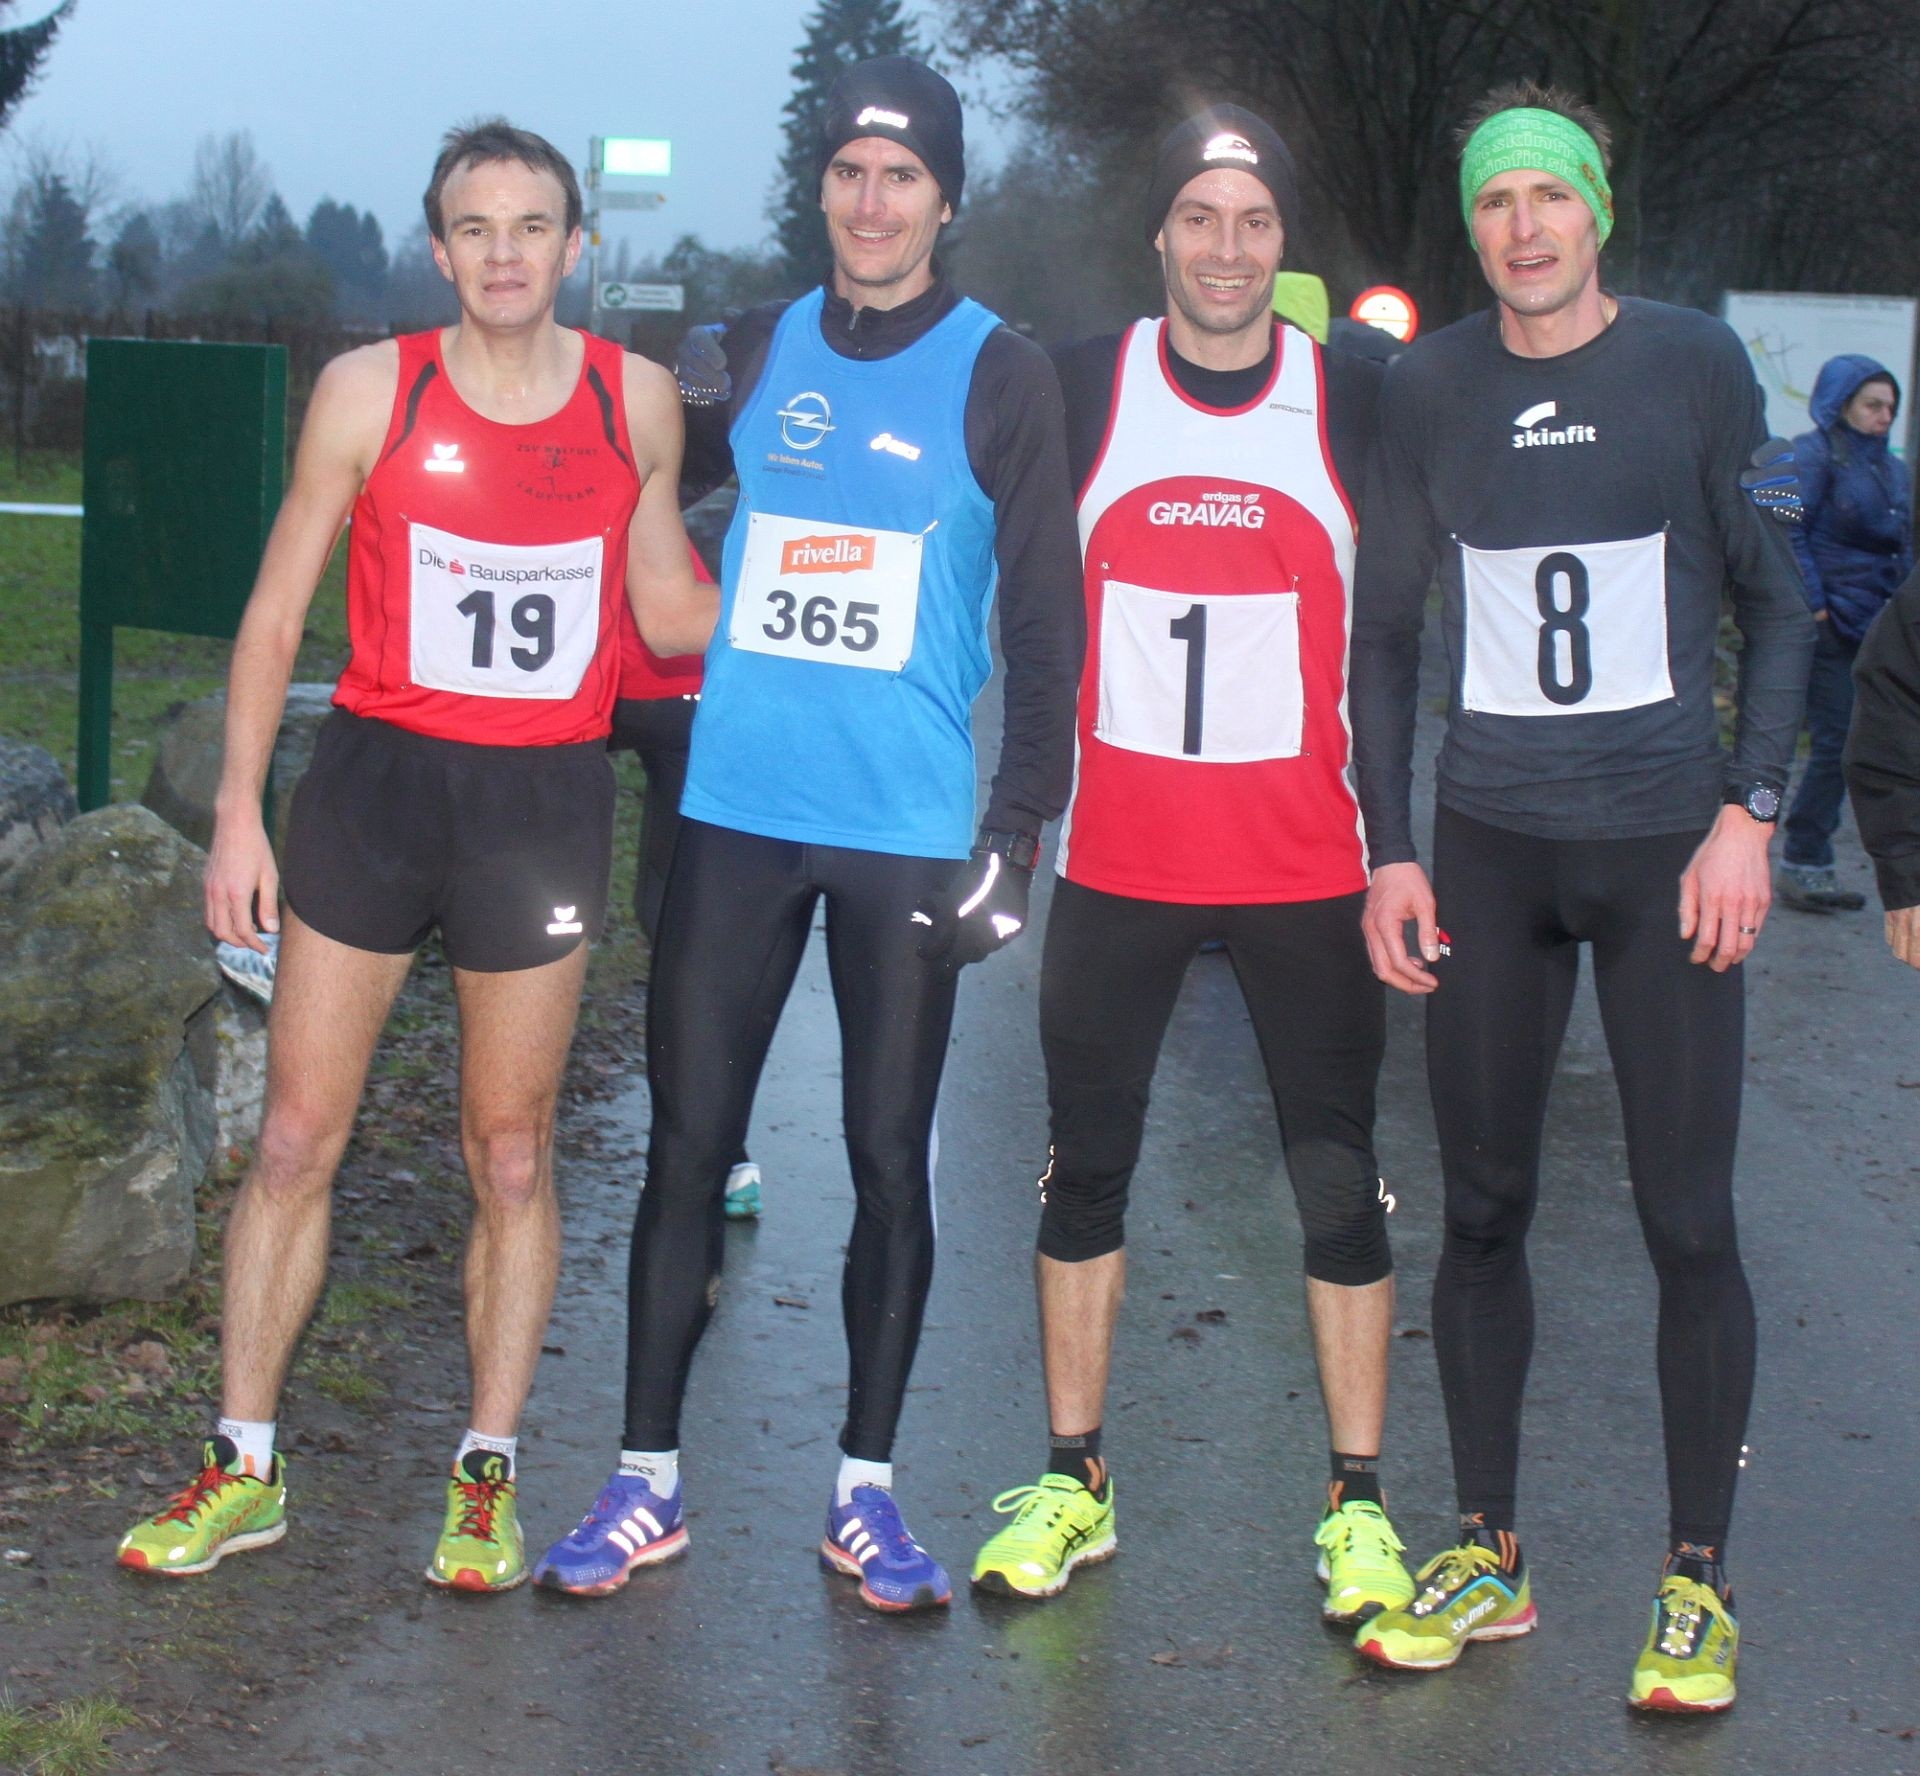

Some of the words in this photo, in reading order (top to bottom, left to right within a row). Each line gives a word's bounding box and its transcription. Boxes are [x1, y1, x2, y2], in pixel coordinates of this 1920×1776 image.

[1512, 425, 1596, 449] skinfit
[1149, 501, 1265, 528] GRAVAG
[1202, 492, 1242, 504] erdgas
[419, 549, 446, 569] Die
[470, 563, 594, 585] Bausparkasse
[791, 538, 863, 566] rivella
[456, 589, 556, 672] 19
[762, 589, 880, 652] 365
[1535, 552, 1593, 706] 8
[1170, 603, 1207, 756] 1
